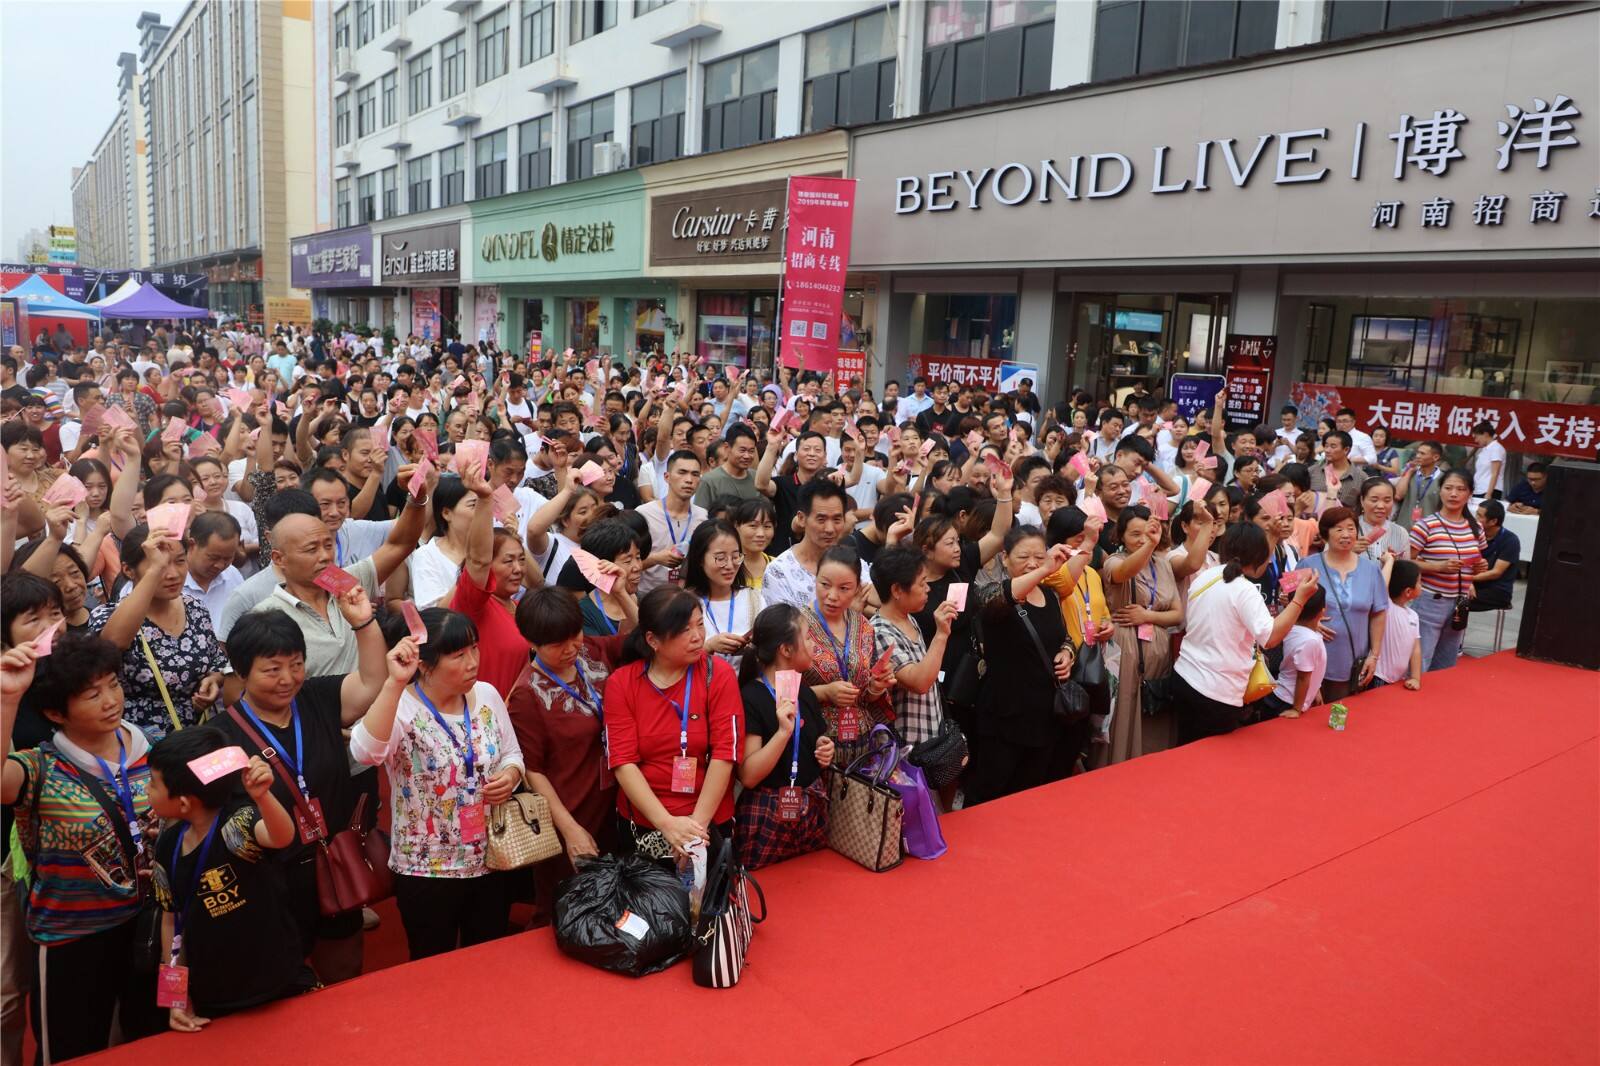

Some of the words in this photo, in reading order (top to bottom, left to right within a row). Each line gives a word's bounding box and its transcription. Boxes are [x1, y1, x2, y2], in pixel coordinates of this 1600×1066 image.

[1389, 94, 1581, 180] 博洋
[895, 152, 1133, 214] BEYOND
[1149, 127, 1329, 193] LIVE
[561, 220, 615, 255] 情定法拉
[802, 226, 836, 248] 河南
[791, 251, 840, 272] 招商专线
[1366, 399, 1441, 434] 大品牌
[203, 884, 239, 909] BOY
